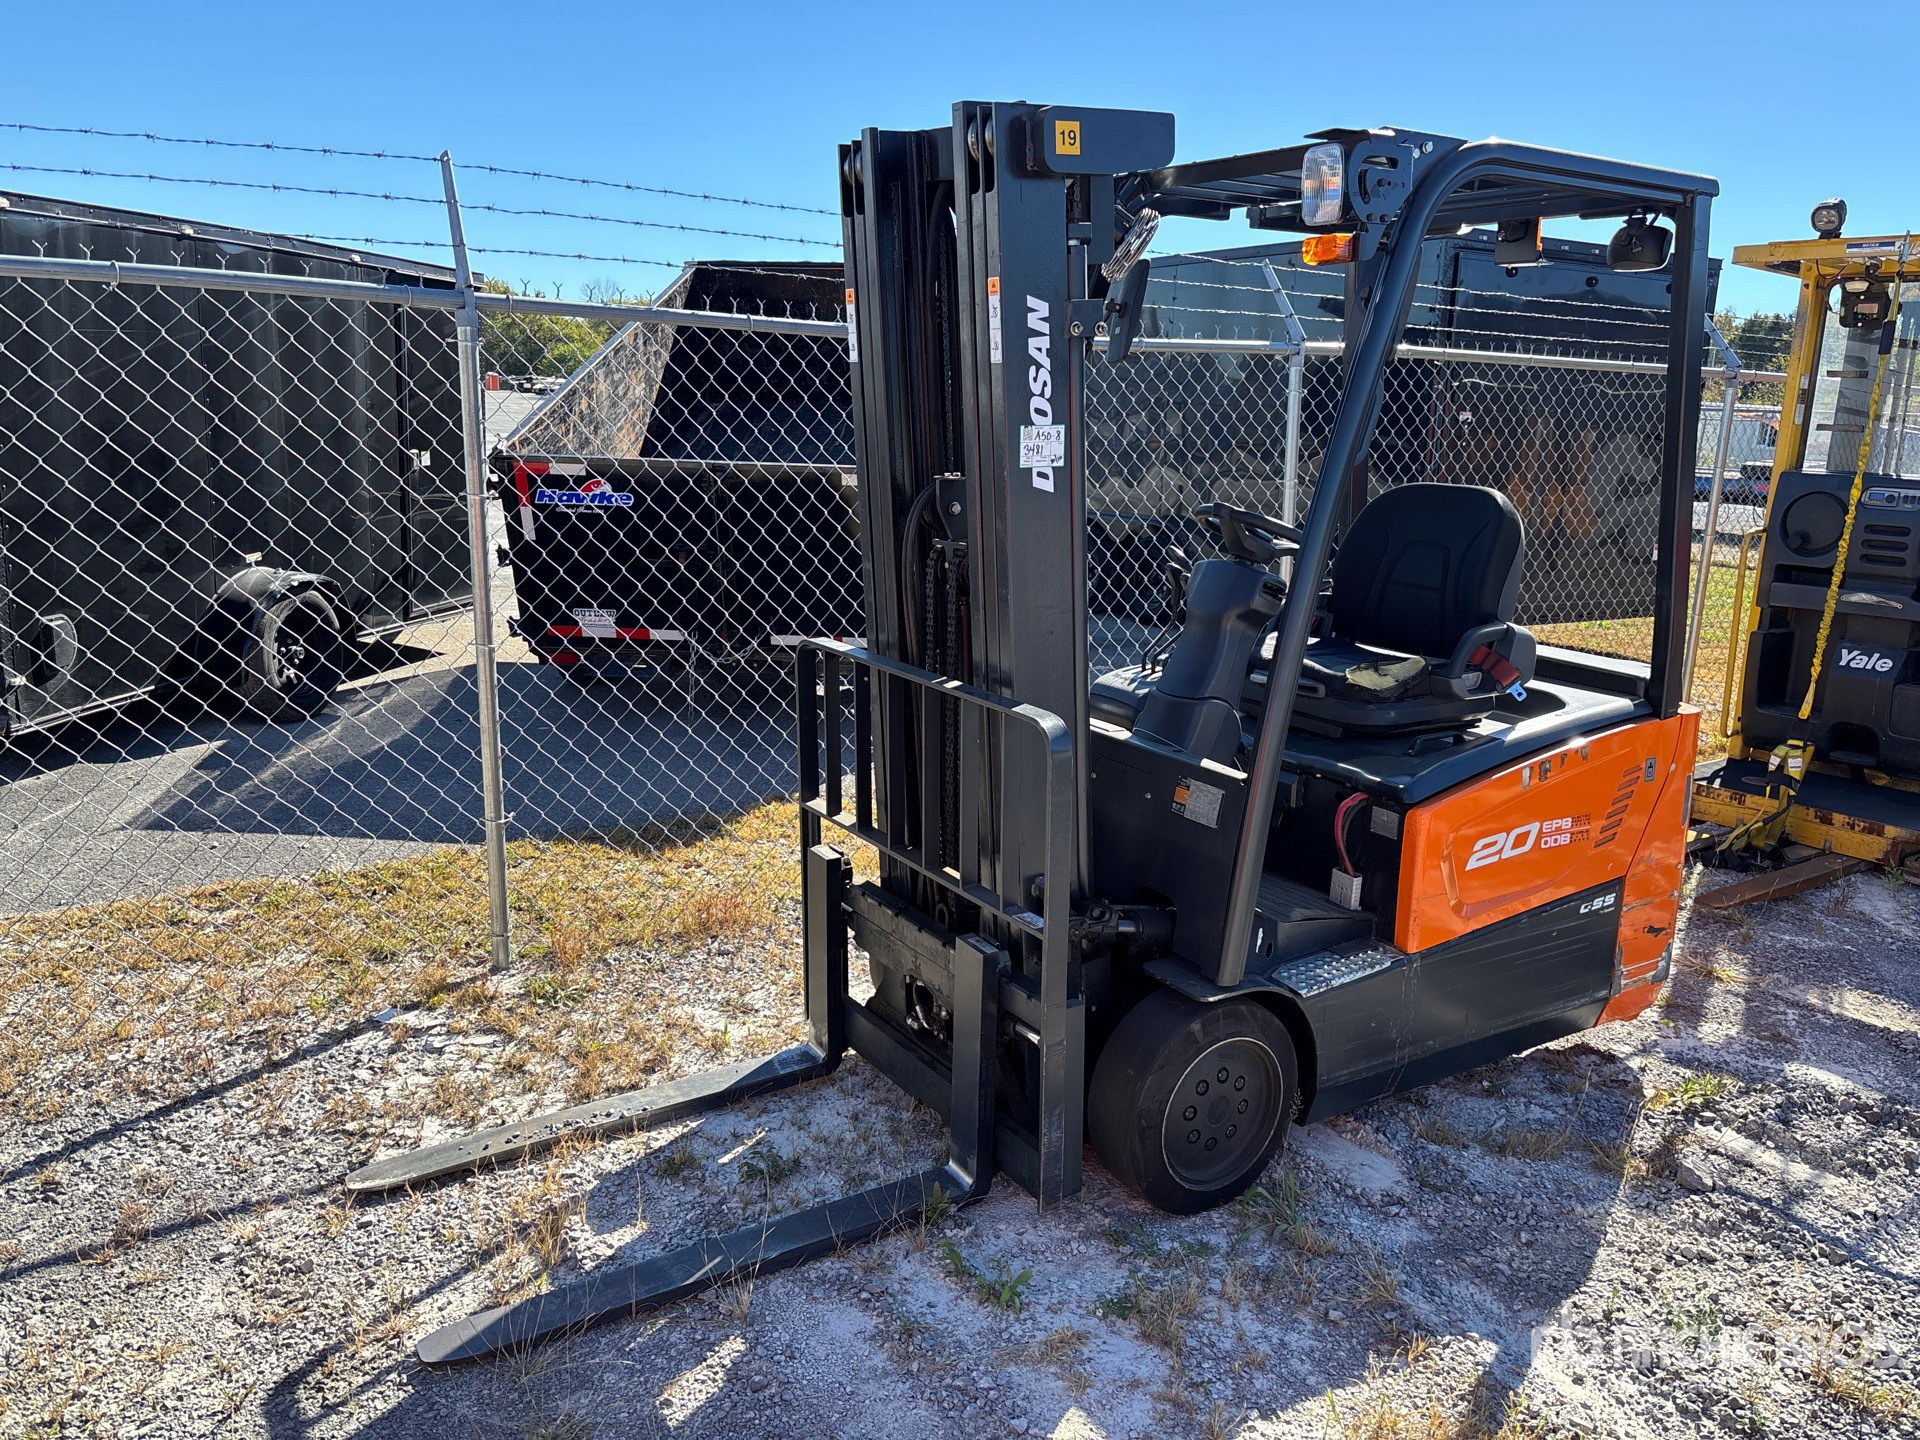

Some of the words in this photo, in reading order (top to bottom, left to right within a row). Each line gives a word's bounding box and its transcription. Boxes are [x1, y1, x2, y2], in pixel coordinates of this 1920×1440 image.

[1059, 129, 1077, 146] 19
[1026, 294, 1055, 493] DOSAN
[1023, 444, 1044, 456] 3481
[535, 489, 634, 507] Hawke
[1838, 648, 1894, 672] Yale
[1542, 817, 1572, 833] EPB
[1465, 821, 1540, 871] 20
[1541, 833, 1571, 849] ODB
